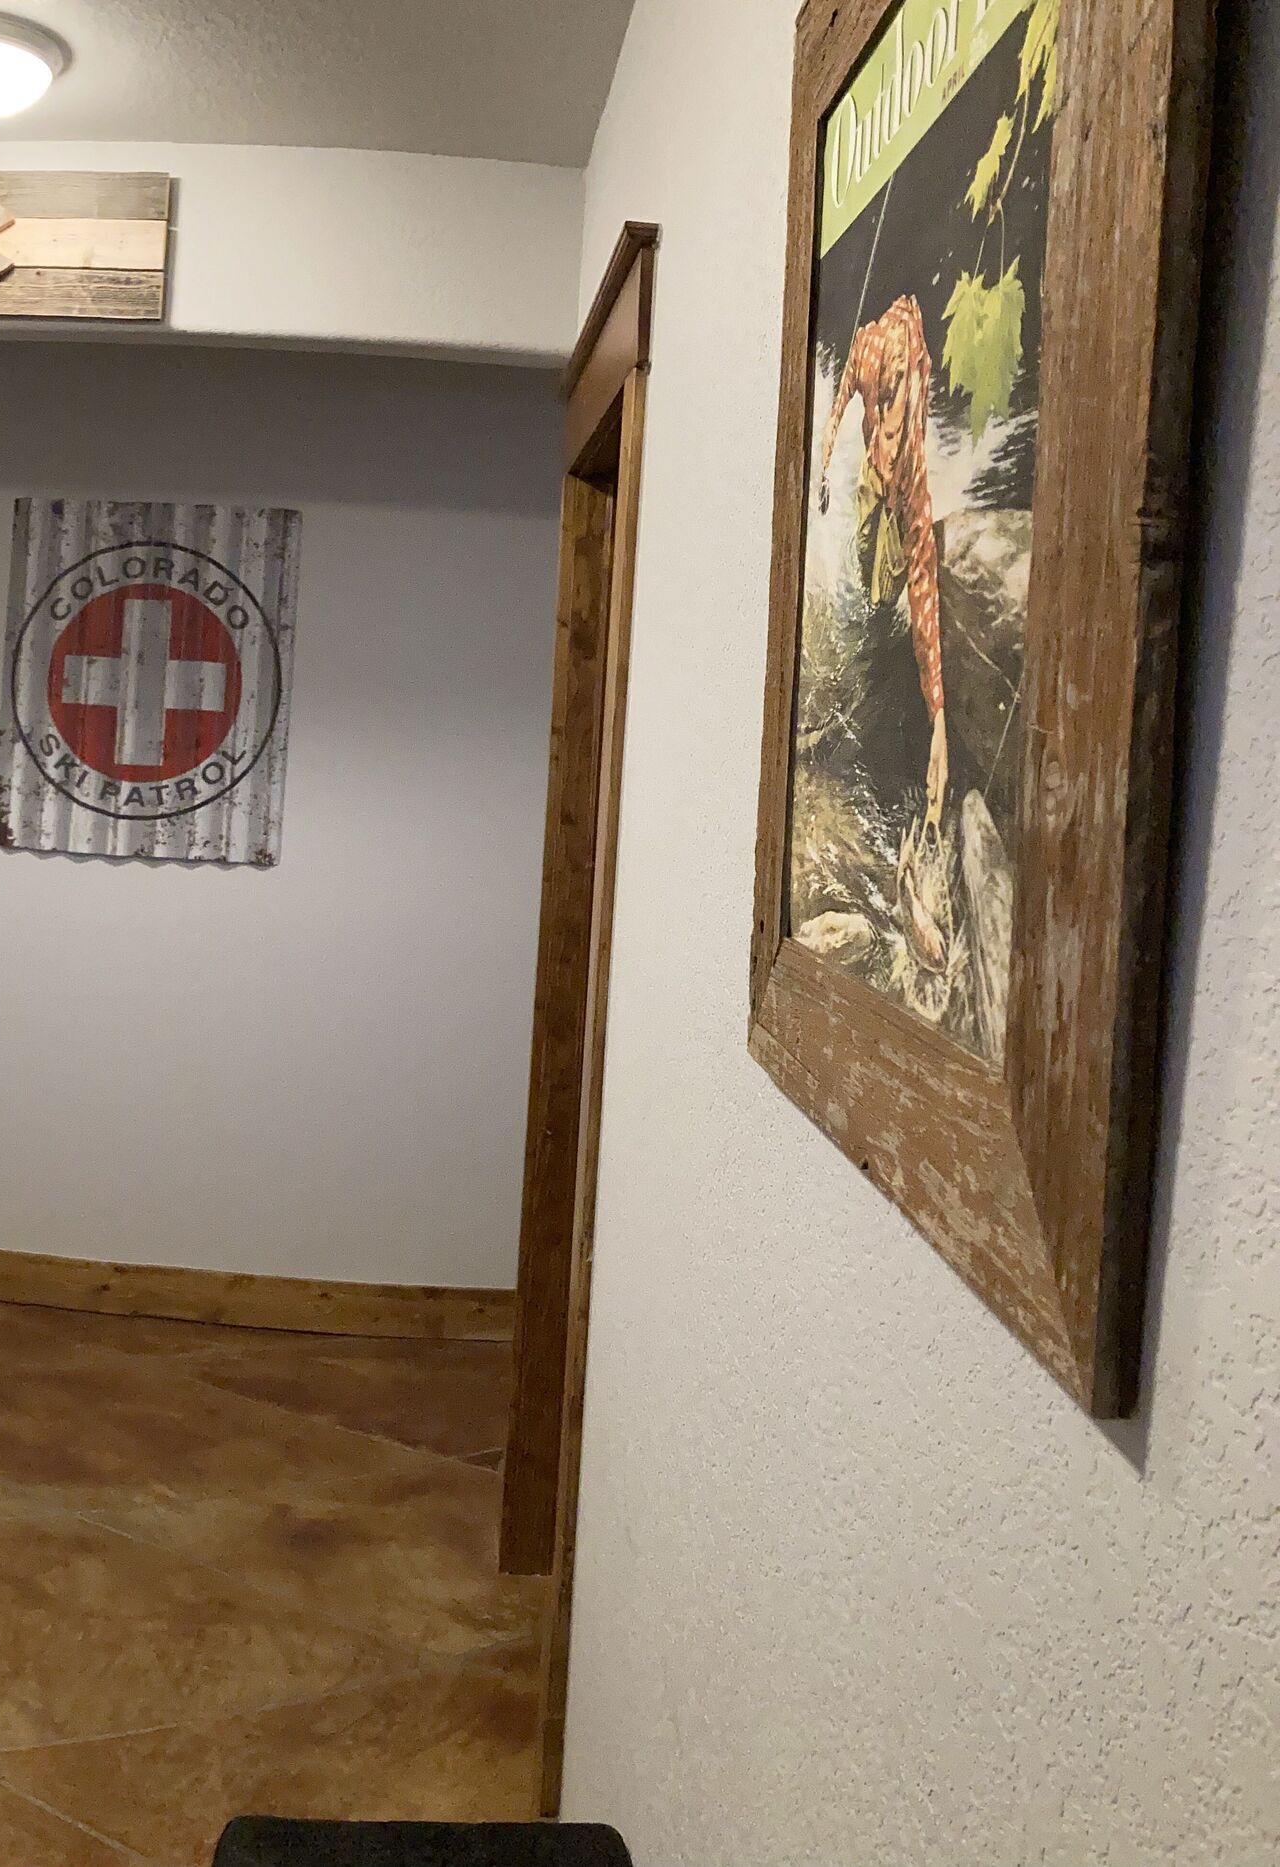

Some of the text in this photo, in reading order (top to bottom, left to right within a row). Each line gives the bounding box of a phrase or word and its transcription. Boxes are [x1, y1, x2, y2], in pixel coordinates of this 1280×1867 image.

[831, 0, 959, 208] Outdoor
[941, 61, 965, 101] APRIL
[50, 556, 249, 630] COLORADO
[39, 733, 247, 807] SKI PATROL
